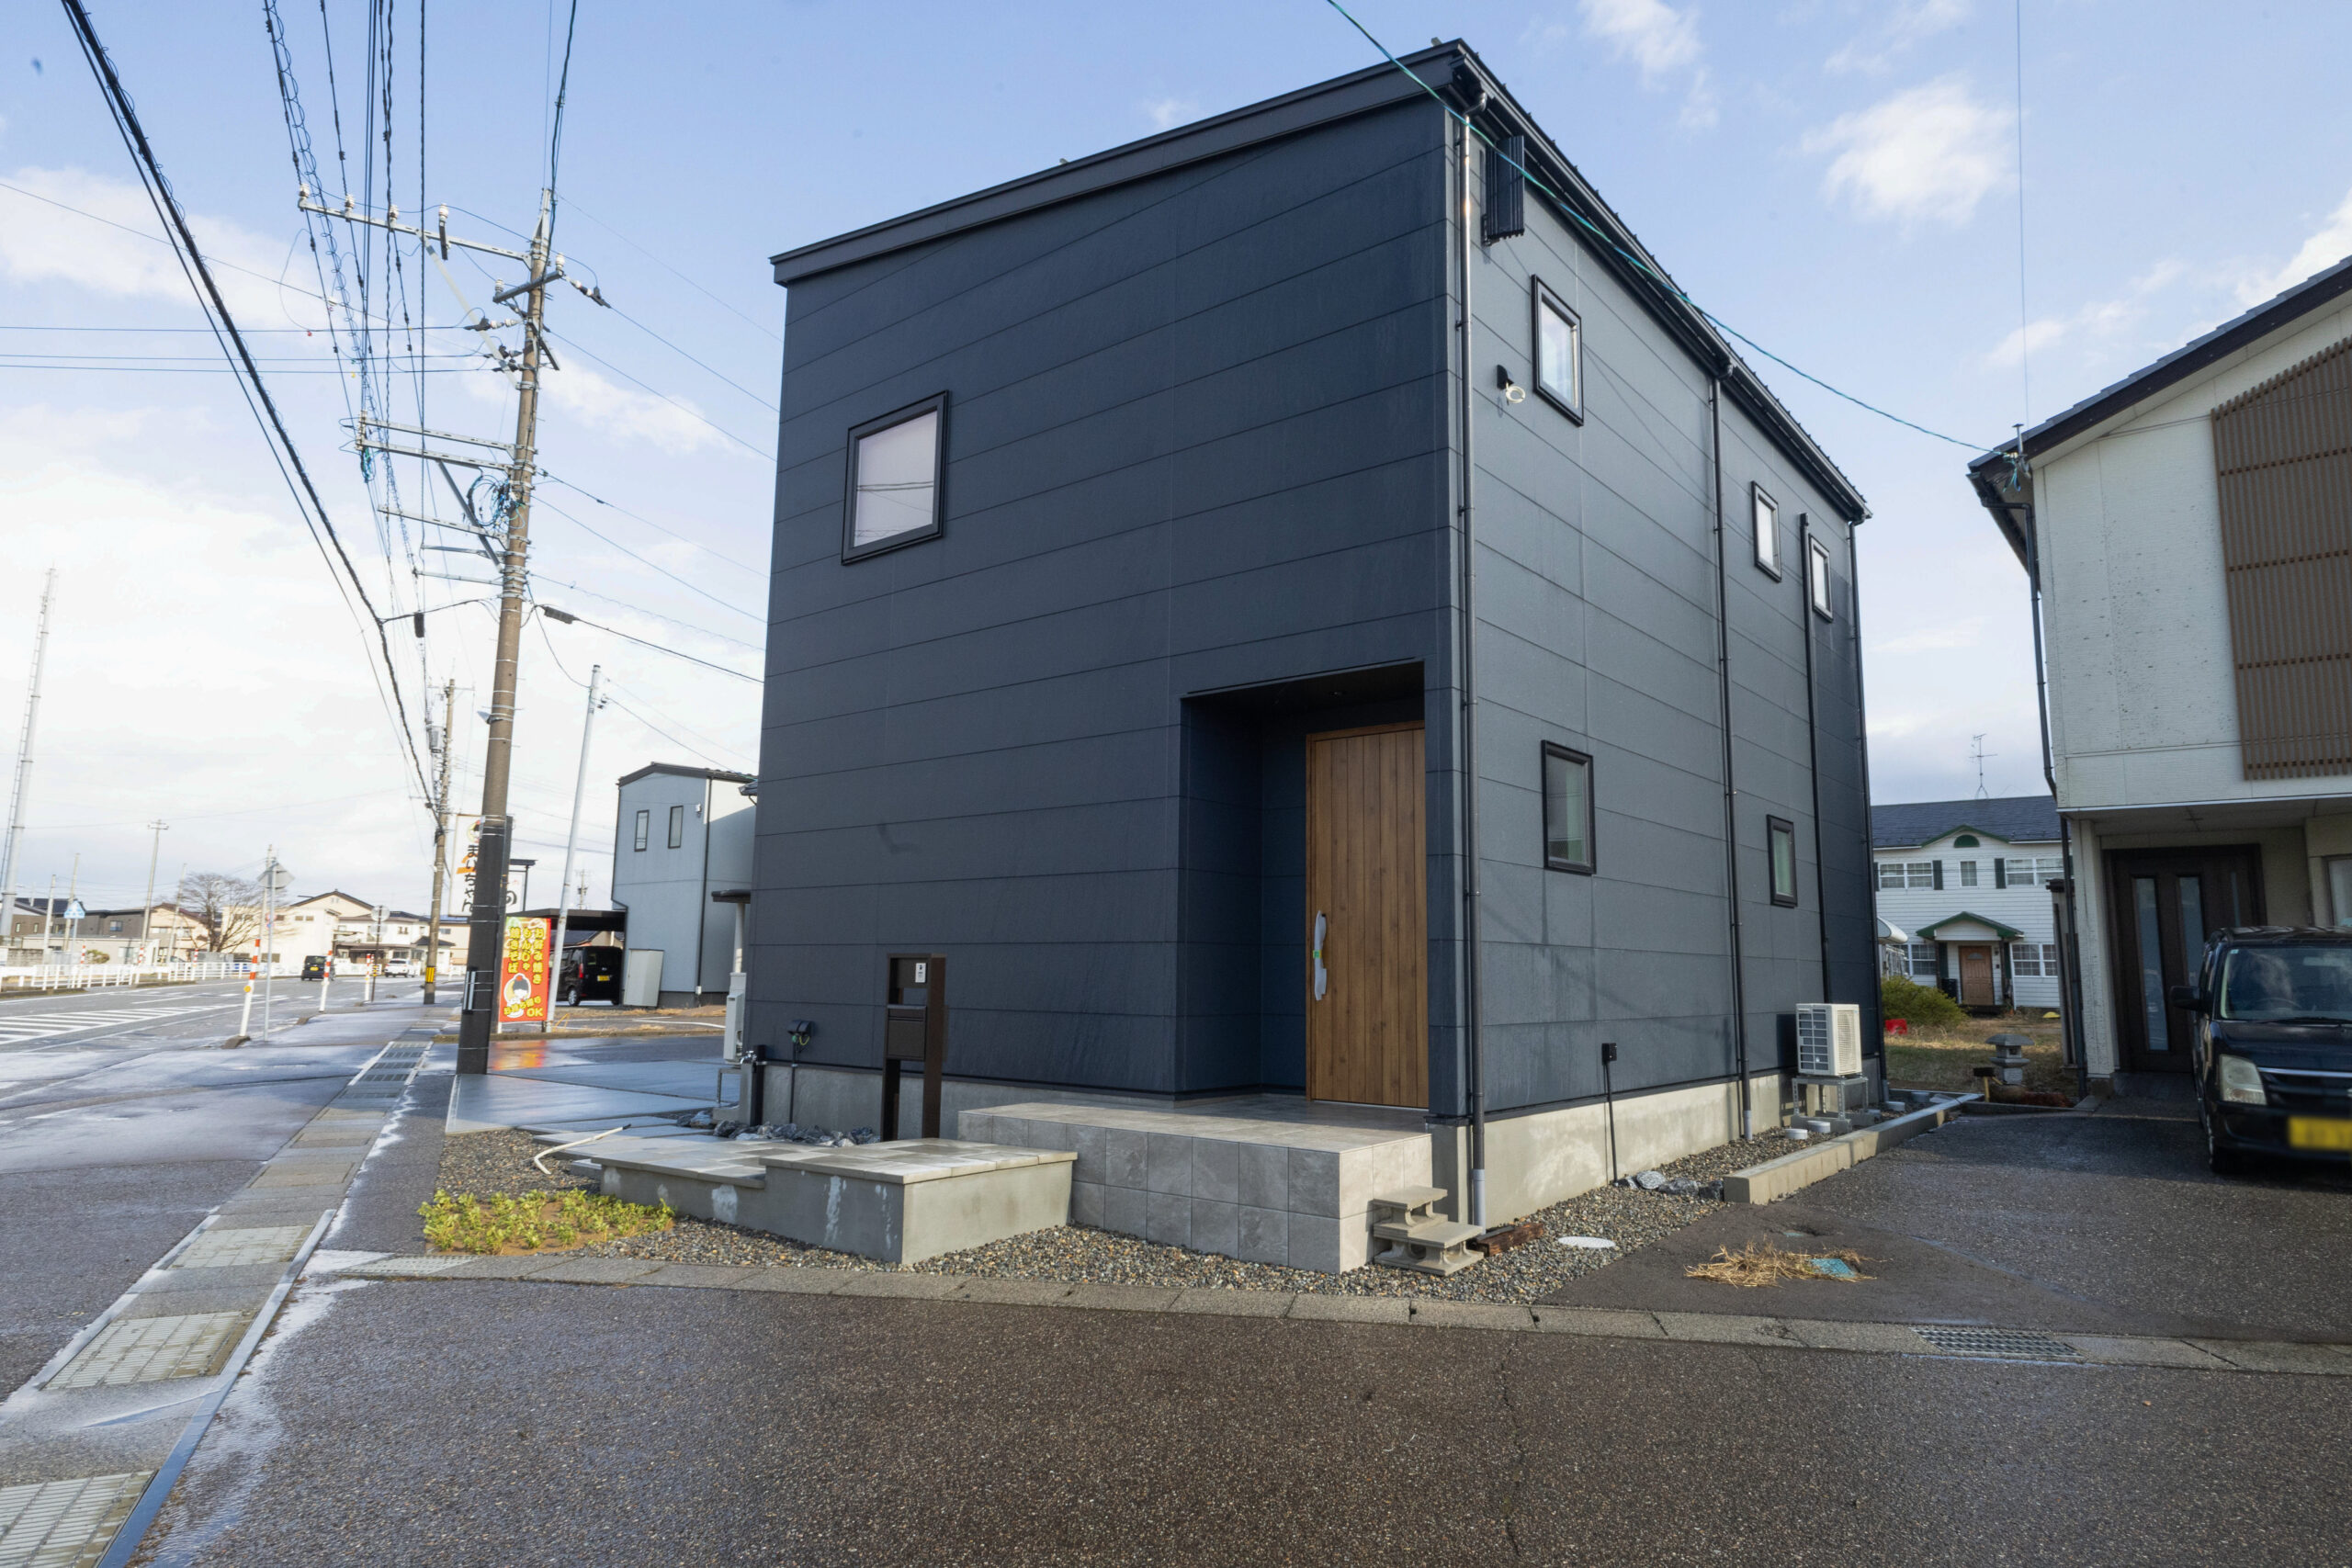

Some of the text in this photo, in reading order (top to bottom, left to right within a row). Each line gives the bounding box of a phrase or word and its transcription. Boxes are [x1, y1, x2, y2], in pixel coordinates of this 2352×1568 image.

[507, 926, 521, 974] 焼きそば
[521, 927, 532, 971] もんじゃ
[532, 928, 544, 985] お好み焼き
[526, 1007, 544, 1018] OK
